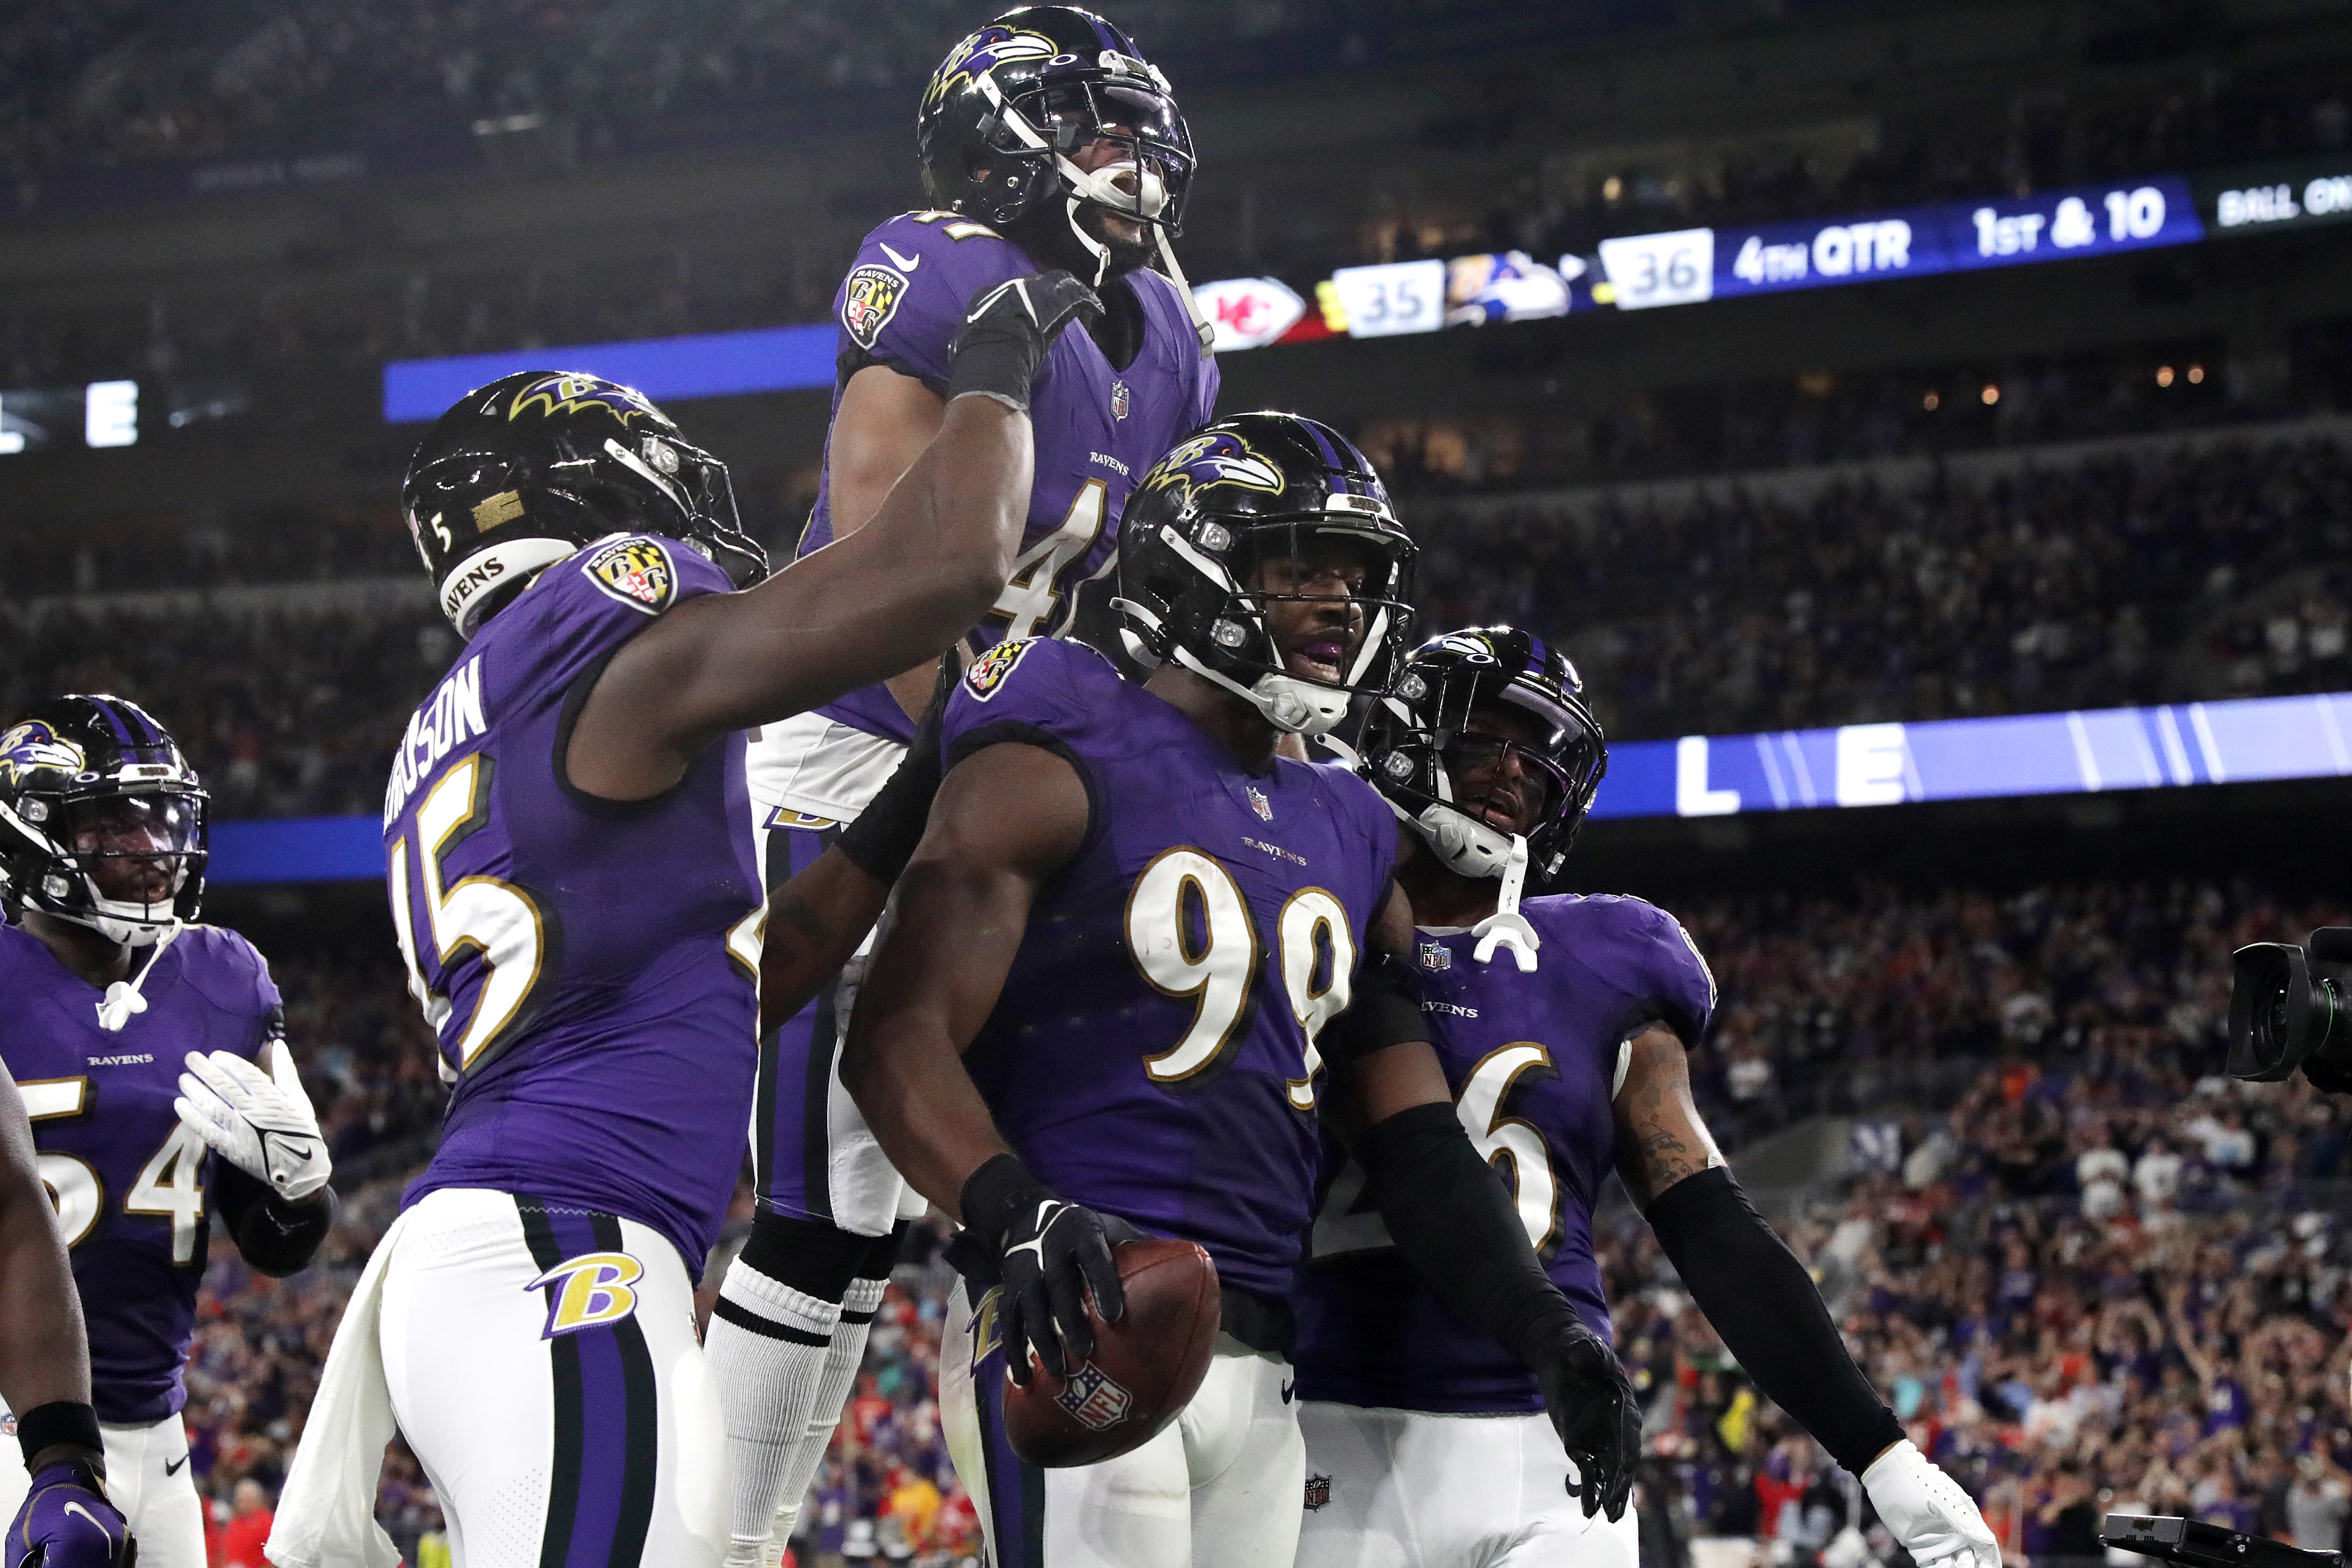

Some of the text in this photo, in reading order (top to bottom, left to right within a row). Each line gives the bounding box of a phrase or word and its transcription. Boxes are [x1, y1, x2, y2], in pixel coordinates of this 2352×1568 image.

[1973, 186, 2166, 257] 1ST & 10
[2217, 184, 2300, 227] BALL
[1633, 247, 1697, 295] 36
[1733, 219, 1912, 285] 4TH QTR
[856, 270, 900, 288] RAVENS
[1363, 278, 1425, 323] 35
[86, 380, 139, 448] E
[1090, 451, 1129, 476] RAVENS
[591, 540, 646, 568] RAVENS
[1676, 722, 1905, 817] L E
[1241, 836, 1307, 866] RAVENS
[1123, 844, 1357, 1111] 99
[1423, 954, 1446, 967] NFL
[1421, 1001, 1478, 1018] VENS
[87, 1053, 154, 1066] RAVENS
[16, 1075, 206, 1268] 54
[524, 1250, 644, 1340] B
[1079, 1387, 1126, 1425] NFL
